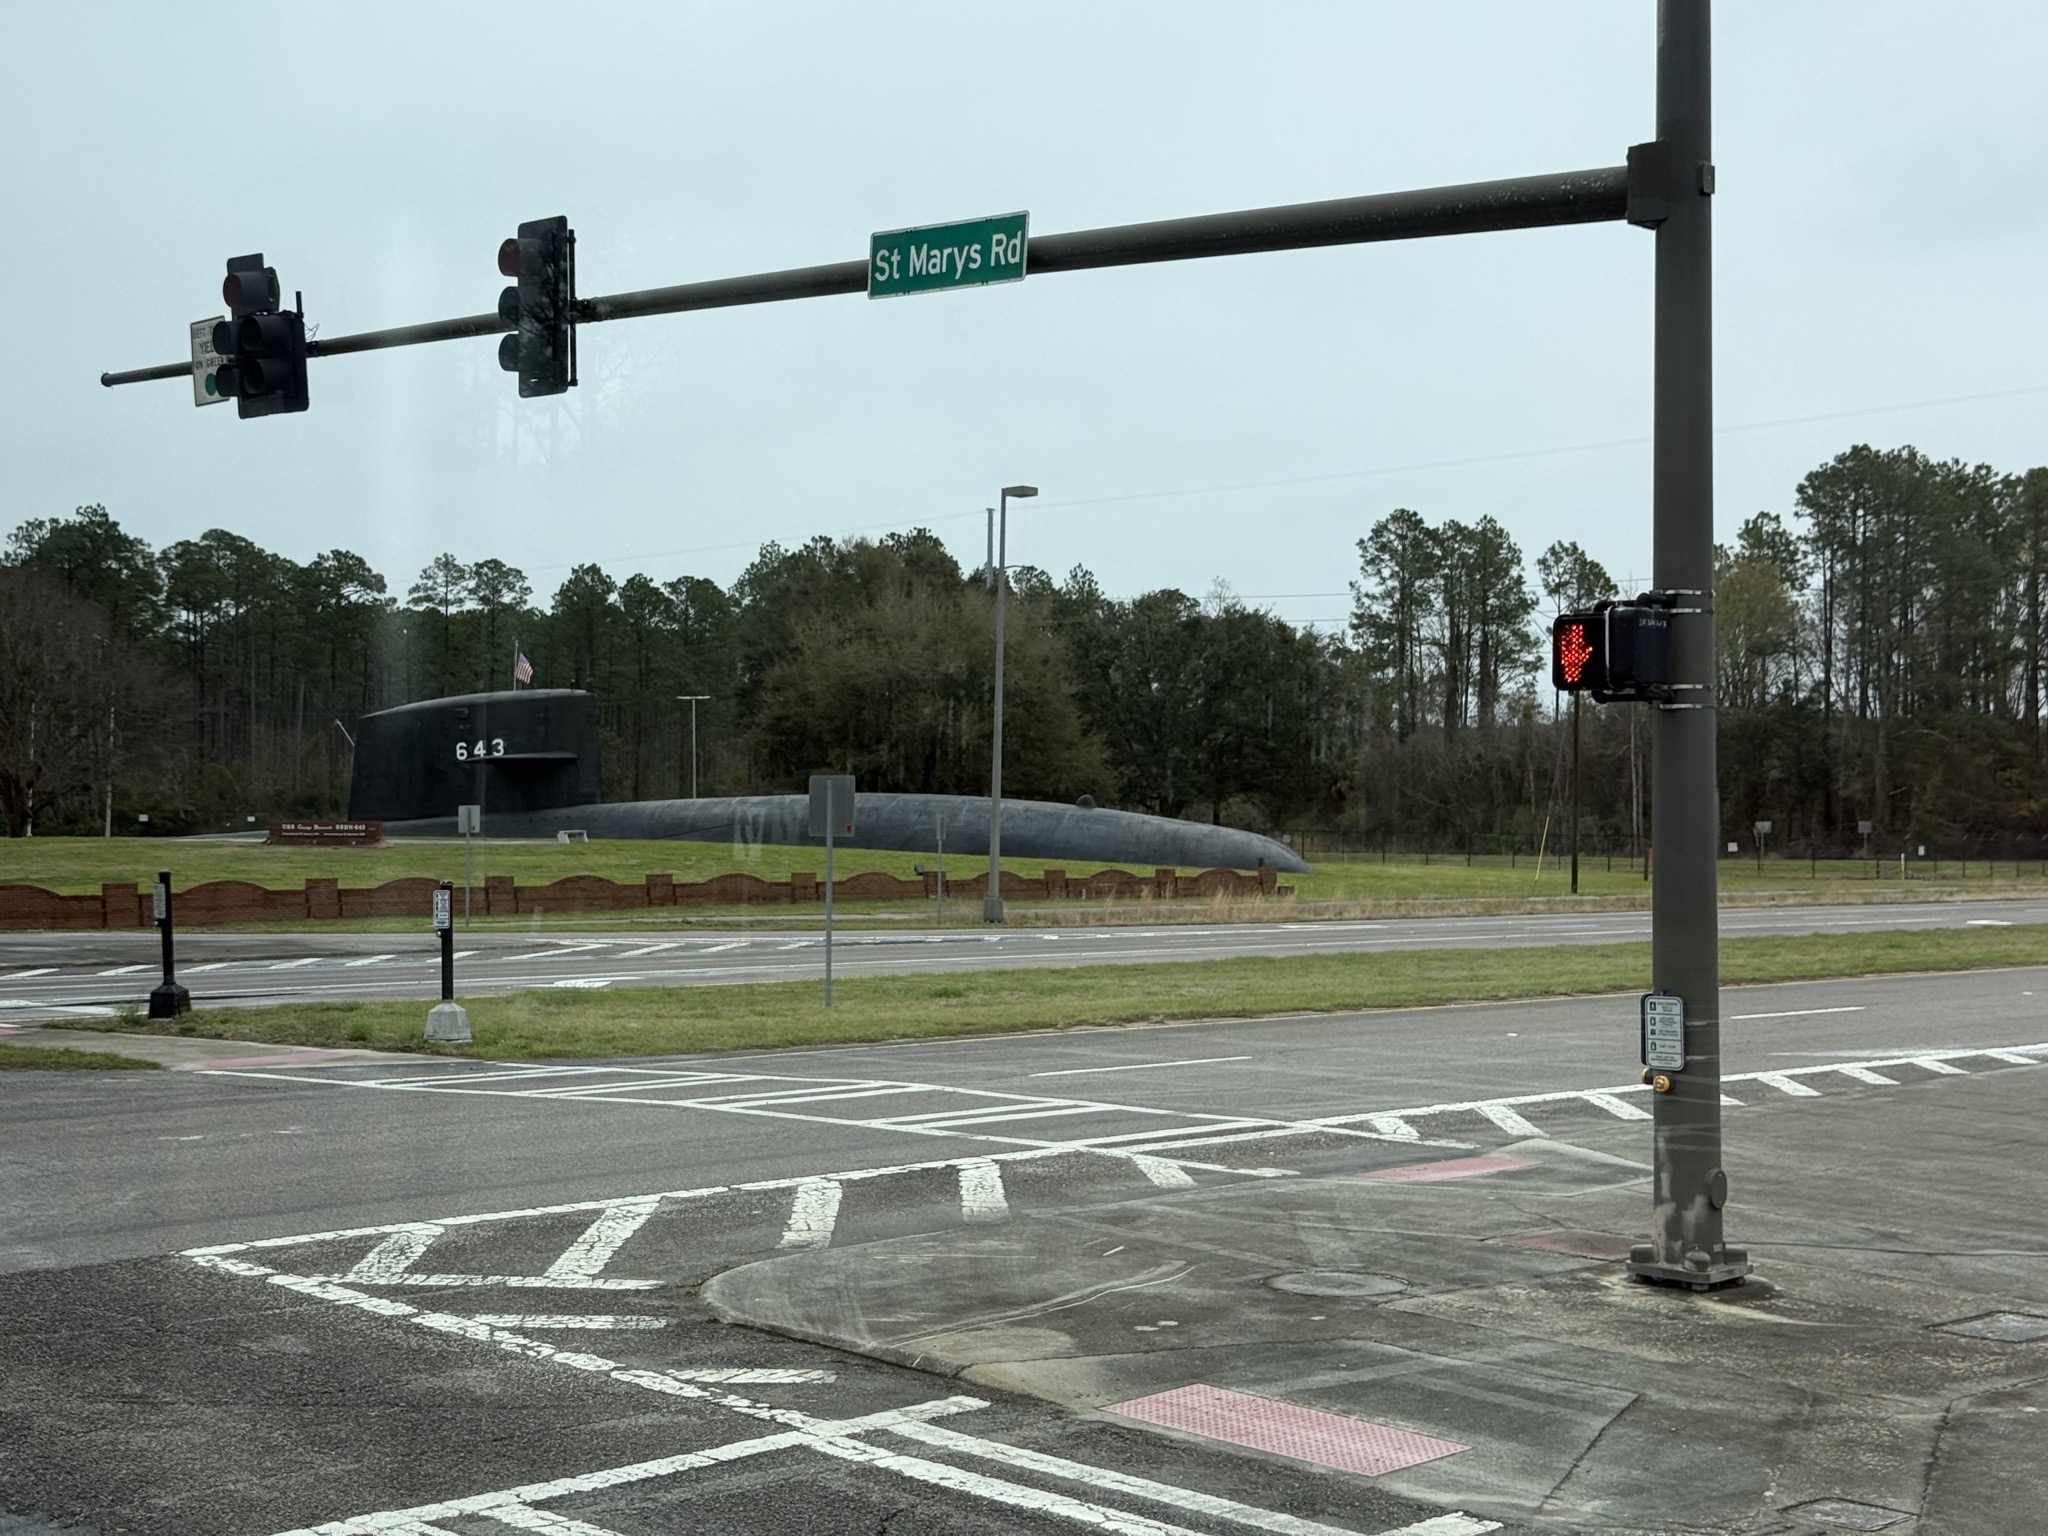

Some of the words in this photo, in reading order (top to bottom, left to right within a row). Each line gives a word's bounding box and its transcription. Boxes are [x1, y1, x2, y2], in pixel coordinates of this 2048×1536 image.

[874, 248, 901, 282] St
[909, 243, 982, 280] Marys
[990, 230, 1022, 267] Rd
[199, 341, 215, 355] YIEL
[456, 738, 504, 760] 643
